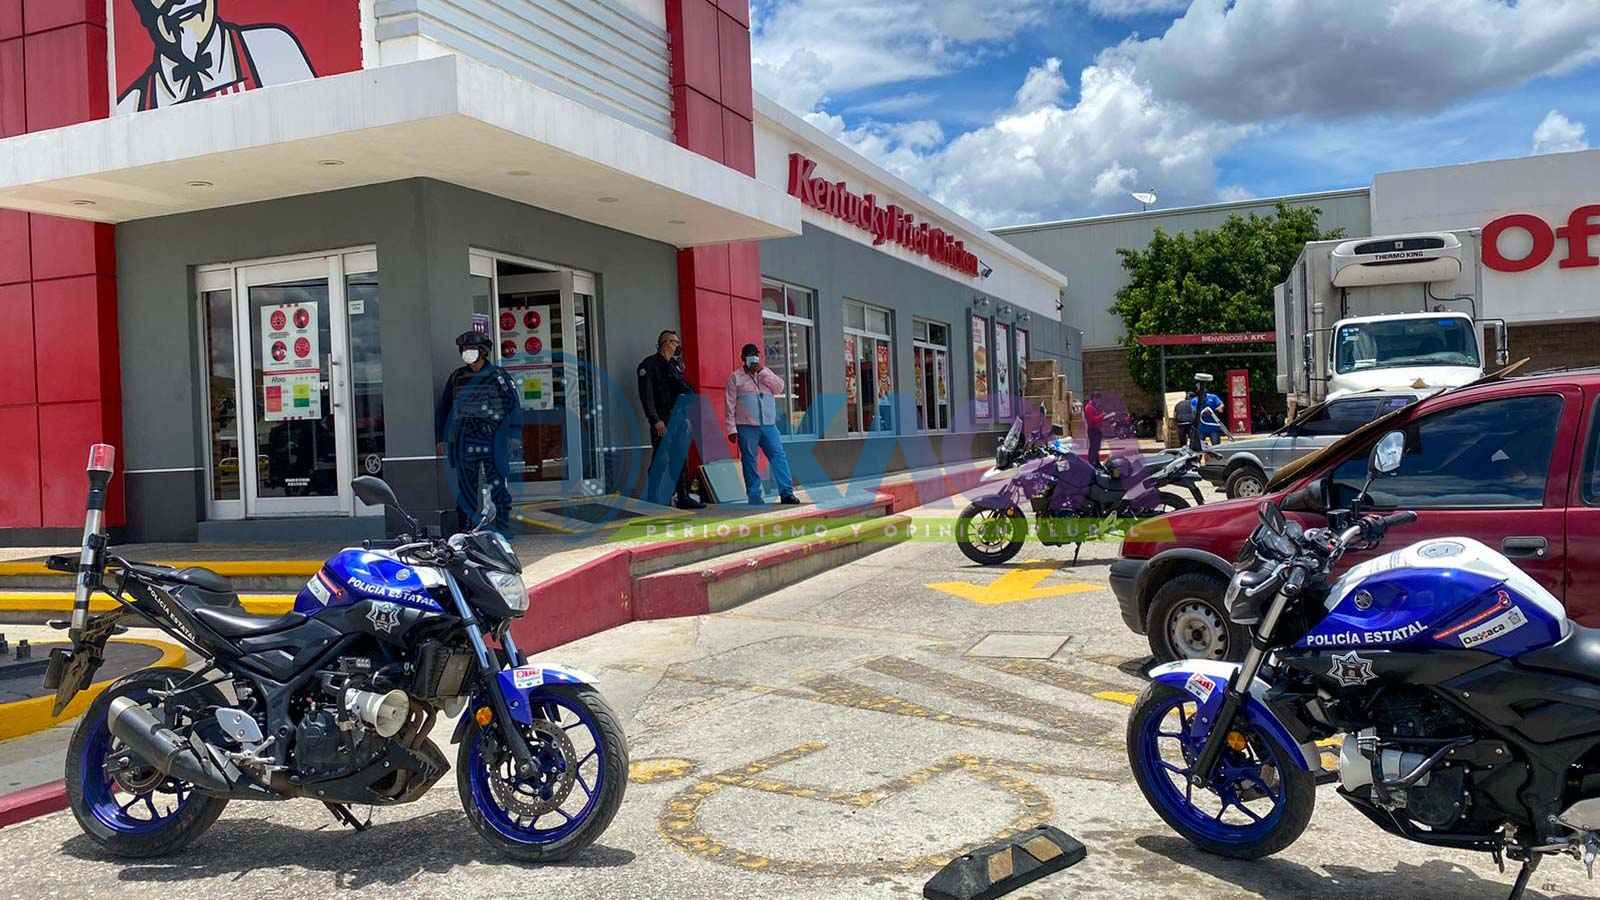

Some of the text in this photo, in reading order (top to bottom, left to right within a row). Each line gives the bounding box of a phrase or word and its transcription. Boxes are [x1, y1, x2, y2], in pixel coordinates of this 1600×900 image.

[787, 152, 979, 278] Kentucky Fried Chicken
[1481, 204, 1600, 273] Of
[1375, 250, 1424, 261] THERMO KING
[388, 588, 435, 606] ESTATAL
[170, 613, 195, 641] ESTATAL
[1306, 621, 1428, 646] POLICÍA ESTATAL
[1463, 623, 1505, 644] Oaxaca
